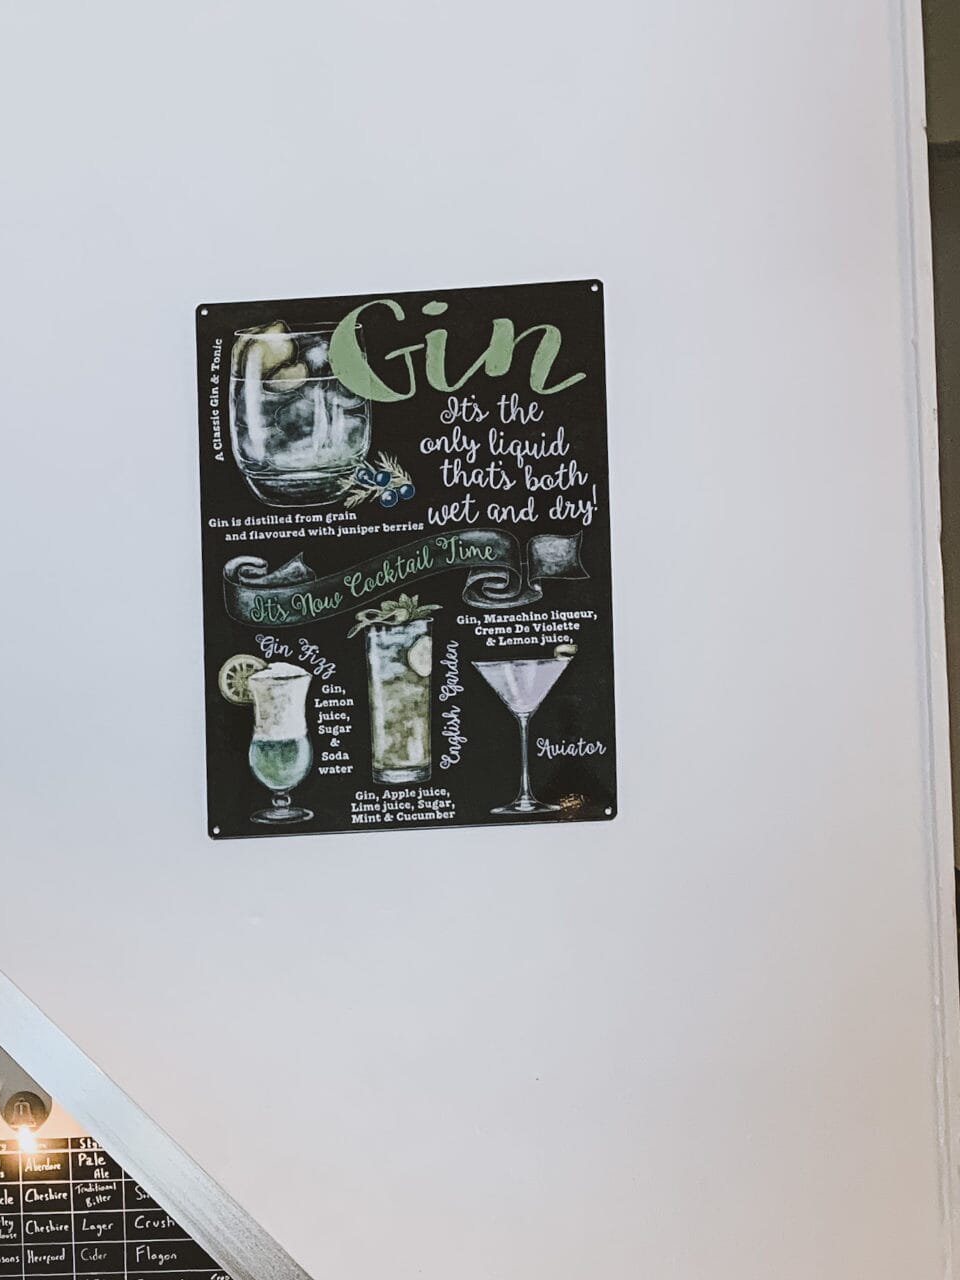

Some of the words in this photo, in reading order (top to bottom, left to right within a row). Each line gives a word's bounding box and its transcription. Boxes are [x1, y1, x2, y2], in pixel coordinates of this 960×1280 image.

[211, 339, 222, 371] Tonic
[328, 299, 586, 402] Gin
[210, 374, 219, 384] &
[209, 387, 219, 407] Gin
[440, 395, 489, 424] It's
[497, 393, 544, 424] the
[210, 409, 222, 450] Classic
[419, 426, 480, 463] only
[489, 427, 569, 468] liquid
[215, 451, 224, 461] A
[440, 459, 516, 490] that's
[525, 460, 588, 490] both
[428, 493, 479, 526] wet
[487, 497, 538, 523] and
[549, 484, 598, 526] dry!
[208, 518, 229, 528] Gin
[231, 517, 241, 527] is
[244, 515, 292, 526] distilled
[295, 513, 323, 524] from
[325, 511, 357, 522] grain
[225, 532, 247, 541] and
[249, 528, 305, 540] flavoured
[308, 527, 335, 536] with
[337, 525, 380, 537] juniper
[383, 521, 424, 532] berries
[250, 595, 290, 622] It's
[292, 592, 343, 618] Now
[344, 546, 434, 597] Cocktail
[436, 536, 497, 564] Time
[456, 615, 481, 625] Gin,
[484, 612, 548, 624] Marachino
[551, 610, 597, 621] liqueur,
[475, 626, 512, 635] Creme
[515, 624, 530, 633] De
[533, 622, 580, 632] Violette
[486, 637, 496, 646] &
[499, 636, 538, 646] Lemon
[540, 634, 573, 645] juice,
[255, 634, 293, 658] Gin
[298, 638, 336, 680] Fizz
[439, 640, 464, 702] Garden
[322, 684, 346, 695] Gin,
[314, 698, 354, 708] Lemon
[317, 711, 350, 723] juice,
[318, 725, 352, 736] Sugar
[440, 705, 468, 769] English
[330, 737, 340, 747] &
[536, 737, 606, 759] Aviator
[321, 751, 350, 761] Soda
[318, 765, 353, 774] water
[355, 790, 379, 801] Gin,
[382, 789, 416, 800] Apple
[417, 787, 450, 799] juice,
[351, 802, 380, 812] Lime
[382, 801, 415, 812] juice,
[418, 799, 455, 810] Sugar,
[351, 814, 381, 823] Mint
[383, 813, 394, 822] &
[396, 811, 455, 821] Cucumber
[78, 1152, 106, 1166] Pale
[93, 1169, 109, 1179] Ale
[25, 1188, 68, 1202] Cheshire
[25, 1220, 69, 1234] Cheshire
[82, 1218, 113, 1237] Lager
[134, 1216, 175, 1229] Crush
[27, 1248, 65, 1264] Hereford
[80, 1247, 107, 1261] Cider
[135, 1245, 177, 1265] Flagon
